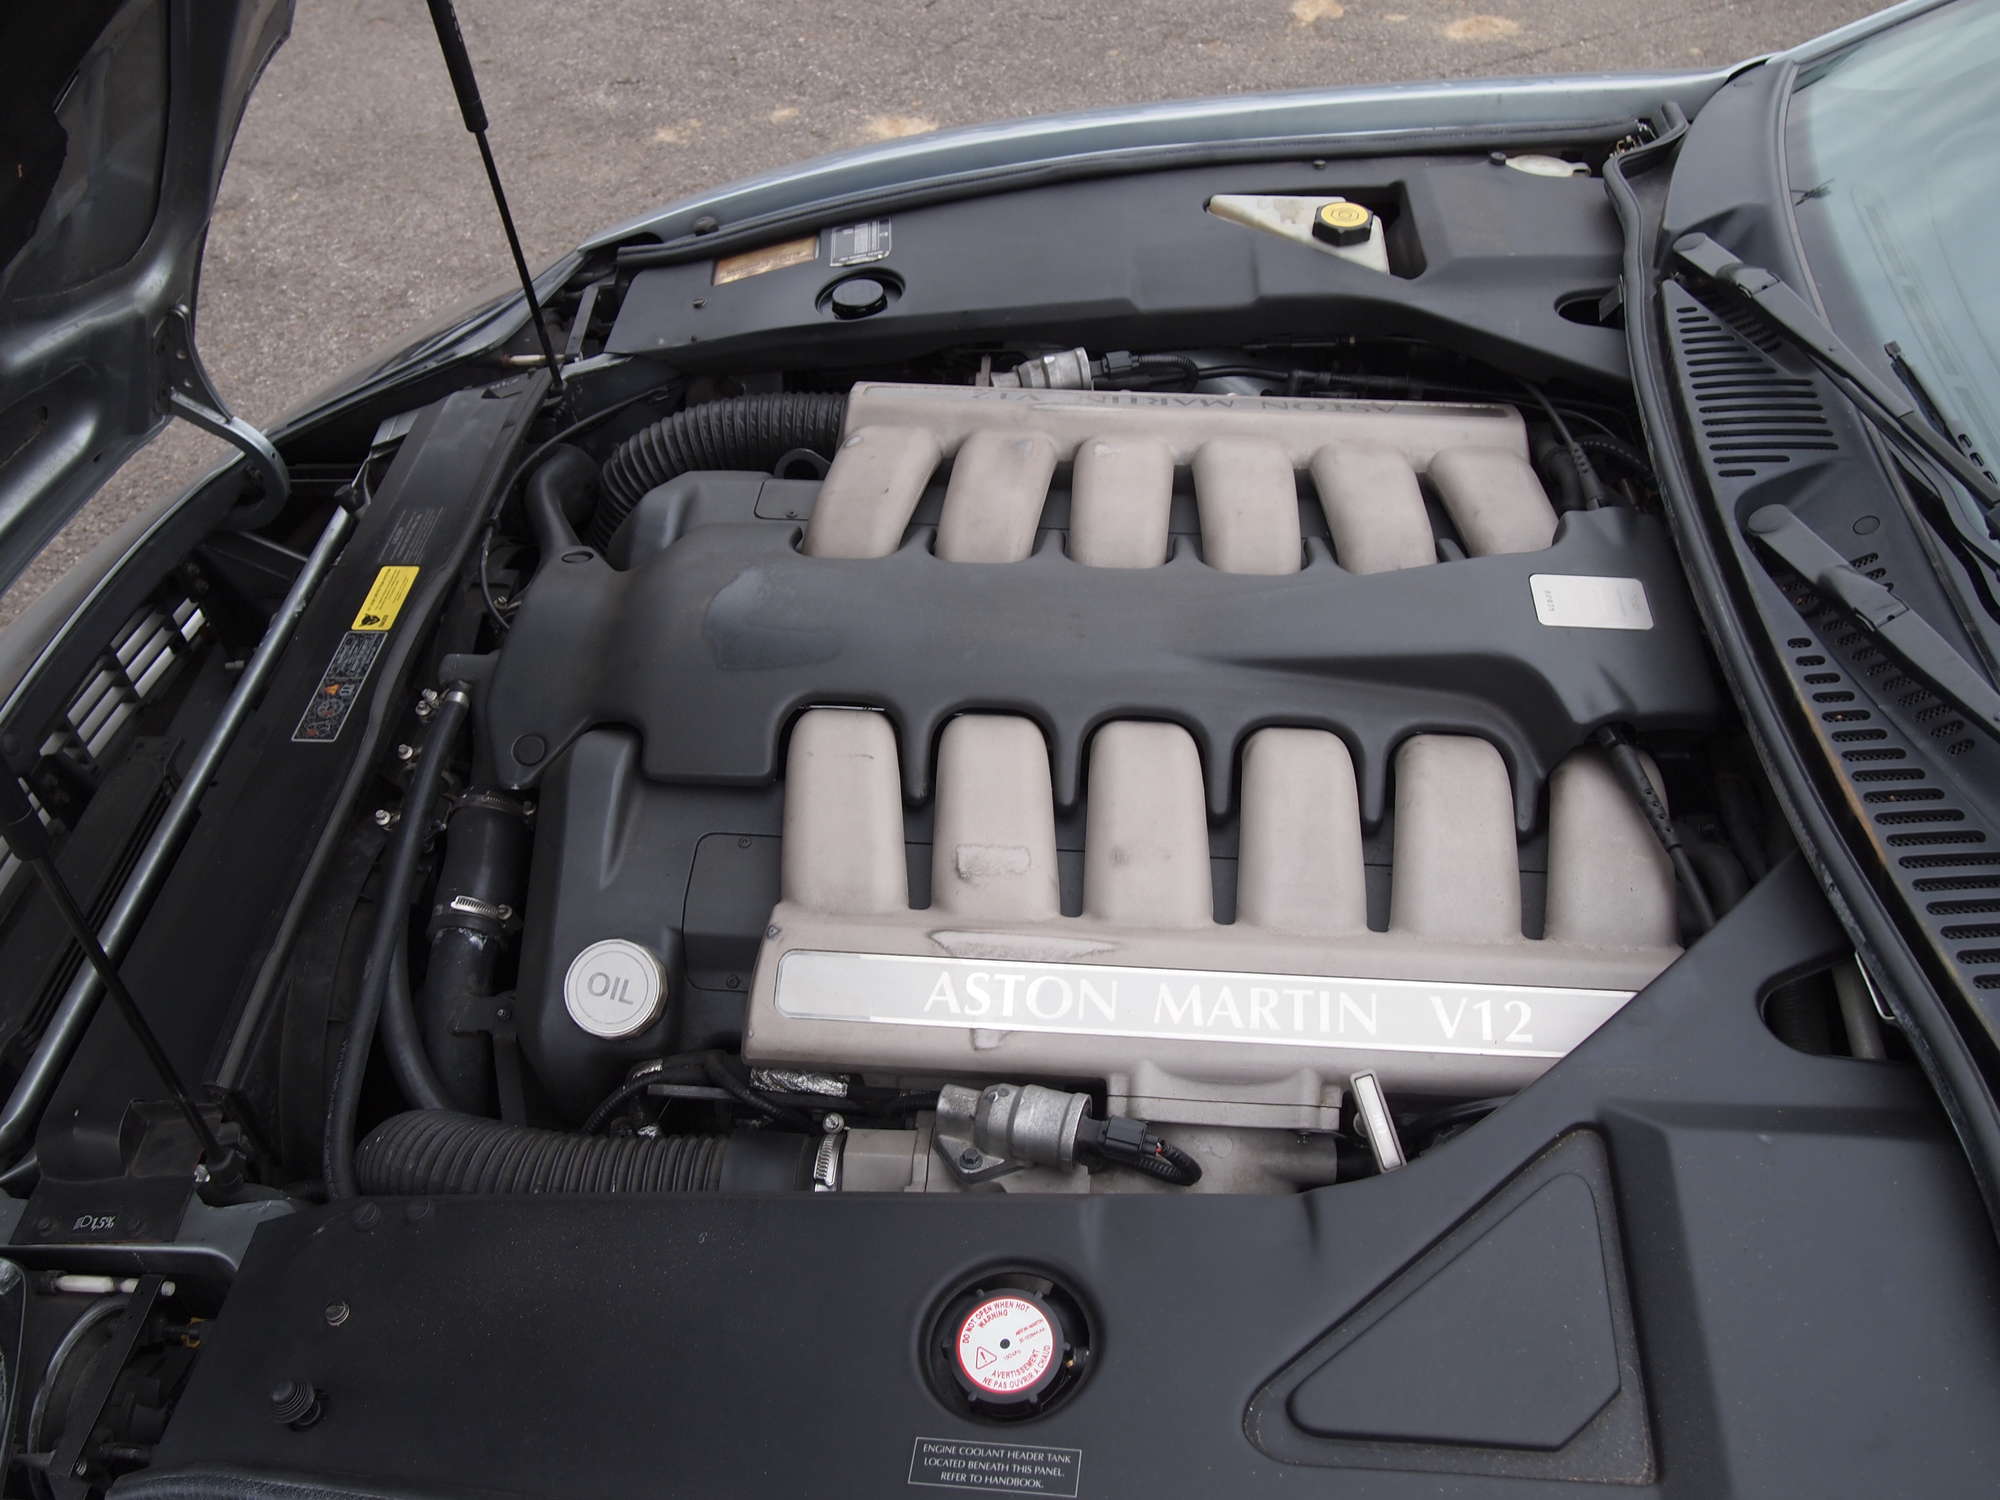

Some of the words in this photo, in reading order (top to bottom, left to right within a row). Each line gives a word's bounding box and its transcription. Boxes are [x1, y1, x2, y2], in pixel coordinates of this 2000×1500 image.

[587, 971, 634, 1006] OIL
[924, 970, 1116, 1022] ASTON
[1153, 979, 1376, 1035] MARTIN
[1428, 994, 1535, 1044] V12
[975, 1305, 993, 1319] OPEN
[994, 1301, 1014, 1309] WHEN
[1015, 1302, 1029, 1312] HOT
[978, 1309, 1008, 1328] WARNING
[982, 1377, 993, 1386] NE
[993, 1379, 1008, 1389] PAS
[1009, 1371, 1034, 1389] OUVRIR
[923, 1443, 957, 1455] ENGINE
[959, 1447, 1005, 1458] COOLANT
[1007, 1450, 1045, 1462] HEADER
[1047, 1454, 1071, 1464] TANK
[923, 1457, 966, 1469] LOCATED
[967, 1460, 1009, 1472] BENEATH
[1012, 1464, 1032, 1474] THIS
[1034, 1466, 1065, 1477] PANEL.
[940, 1471, 967, 1483] REFER
[970, 1474, 982, 1484] TO
[985, 1475, 1044, 1488] HANDBOOK.
